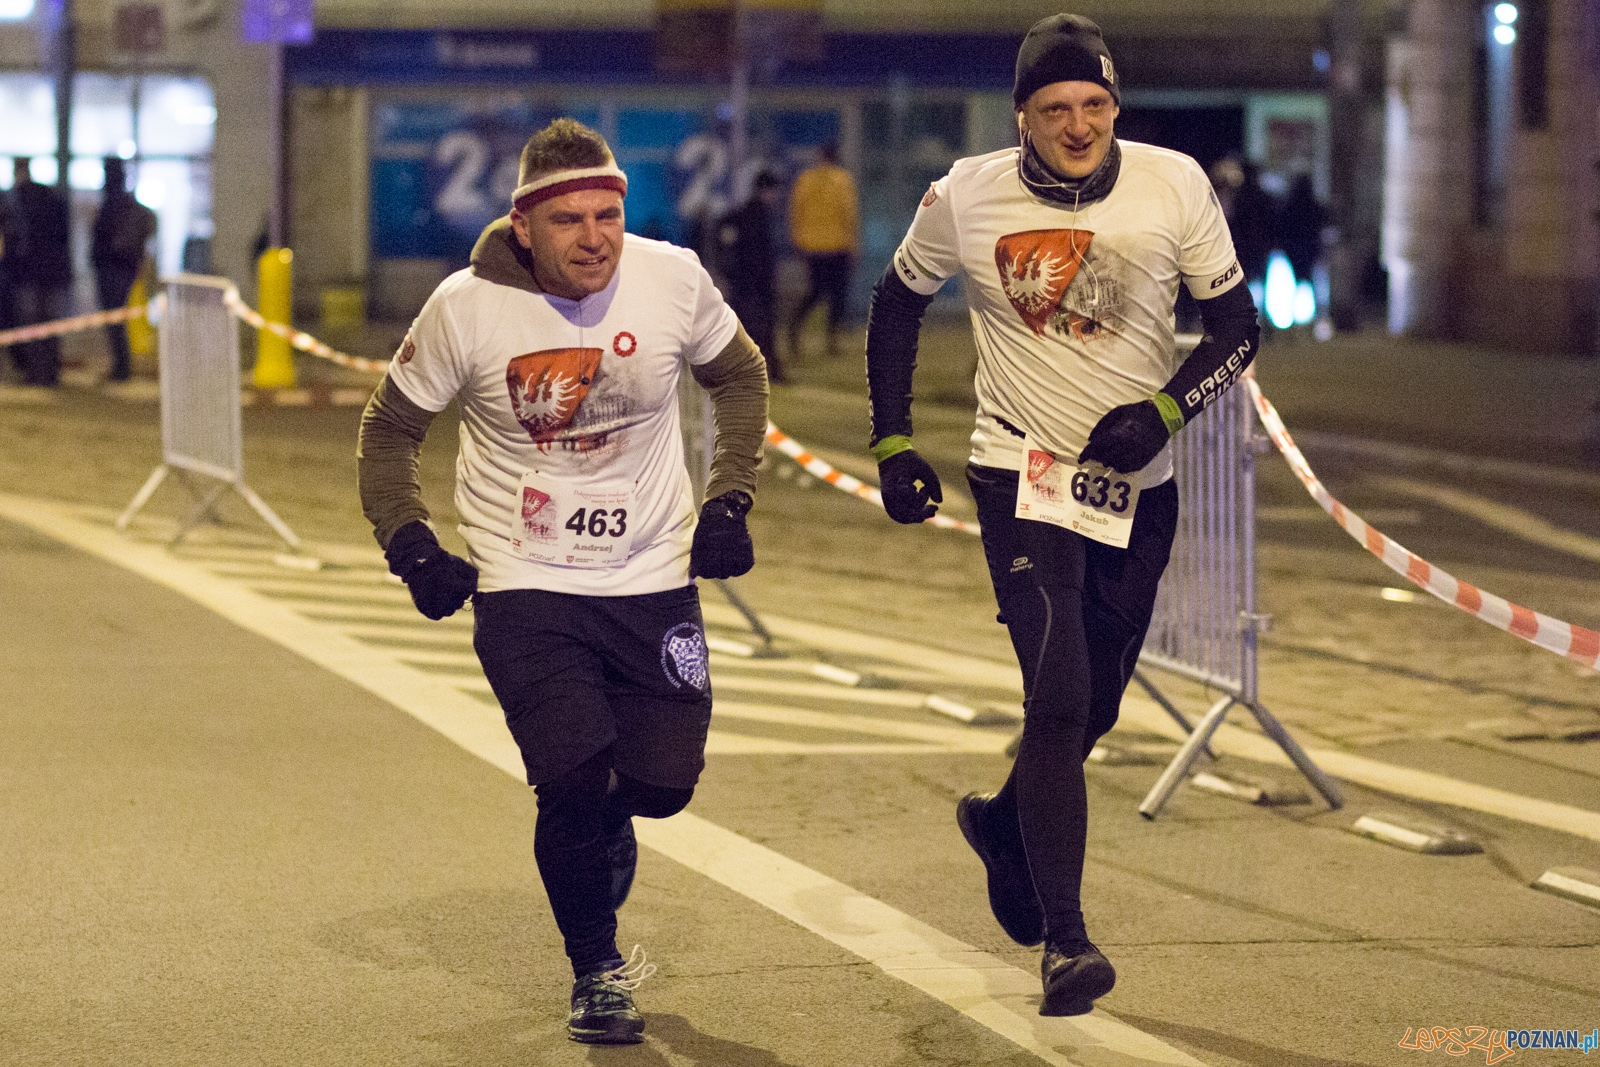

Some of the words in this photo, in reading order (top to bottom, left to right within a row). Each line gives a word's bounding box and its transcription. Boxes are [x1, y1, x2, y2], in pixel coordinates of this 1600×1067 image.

[1184, 339, 1251, 408] GREEN
[1071, 471, 1131, 513] 633
[565, 507, 628, 538] 463
[1080, 510, 1109, 526] Jakub
[573, 543, 613, 554] Andrzej
